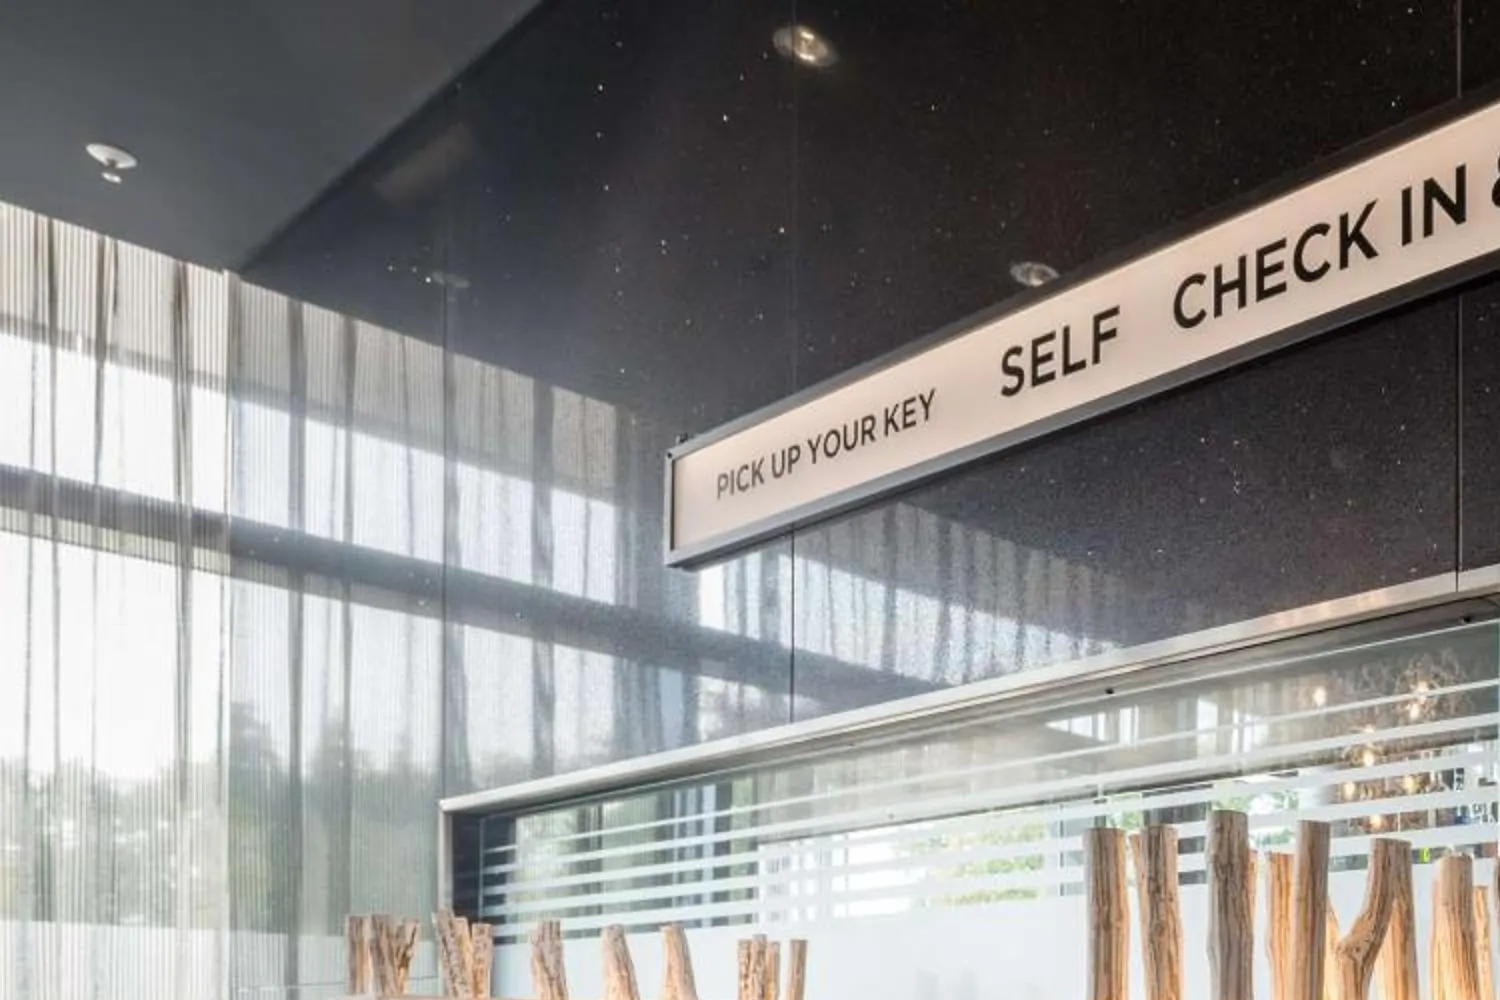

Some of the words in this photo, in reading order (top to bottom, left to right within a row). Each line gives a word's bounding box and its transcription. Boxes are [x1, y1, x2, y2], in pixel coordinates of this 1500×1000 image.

[1000, 304, 1121, 398] SELF
[1172, 199, 1378, 330] CHECK
[1400, 163, 1469, 248] IN
[716, 457, 766, 498] PICK
[771, 443, 801, 480] UP
[806, 414, 877, 465] YOUR
[884, 388, 936, 438] KEY
